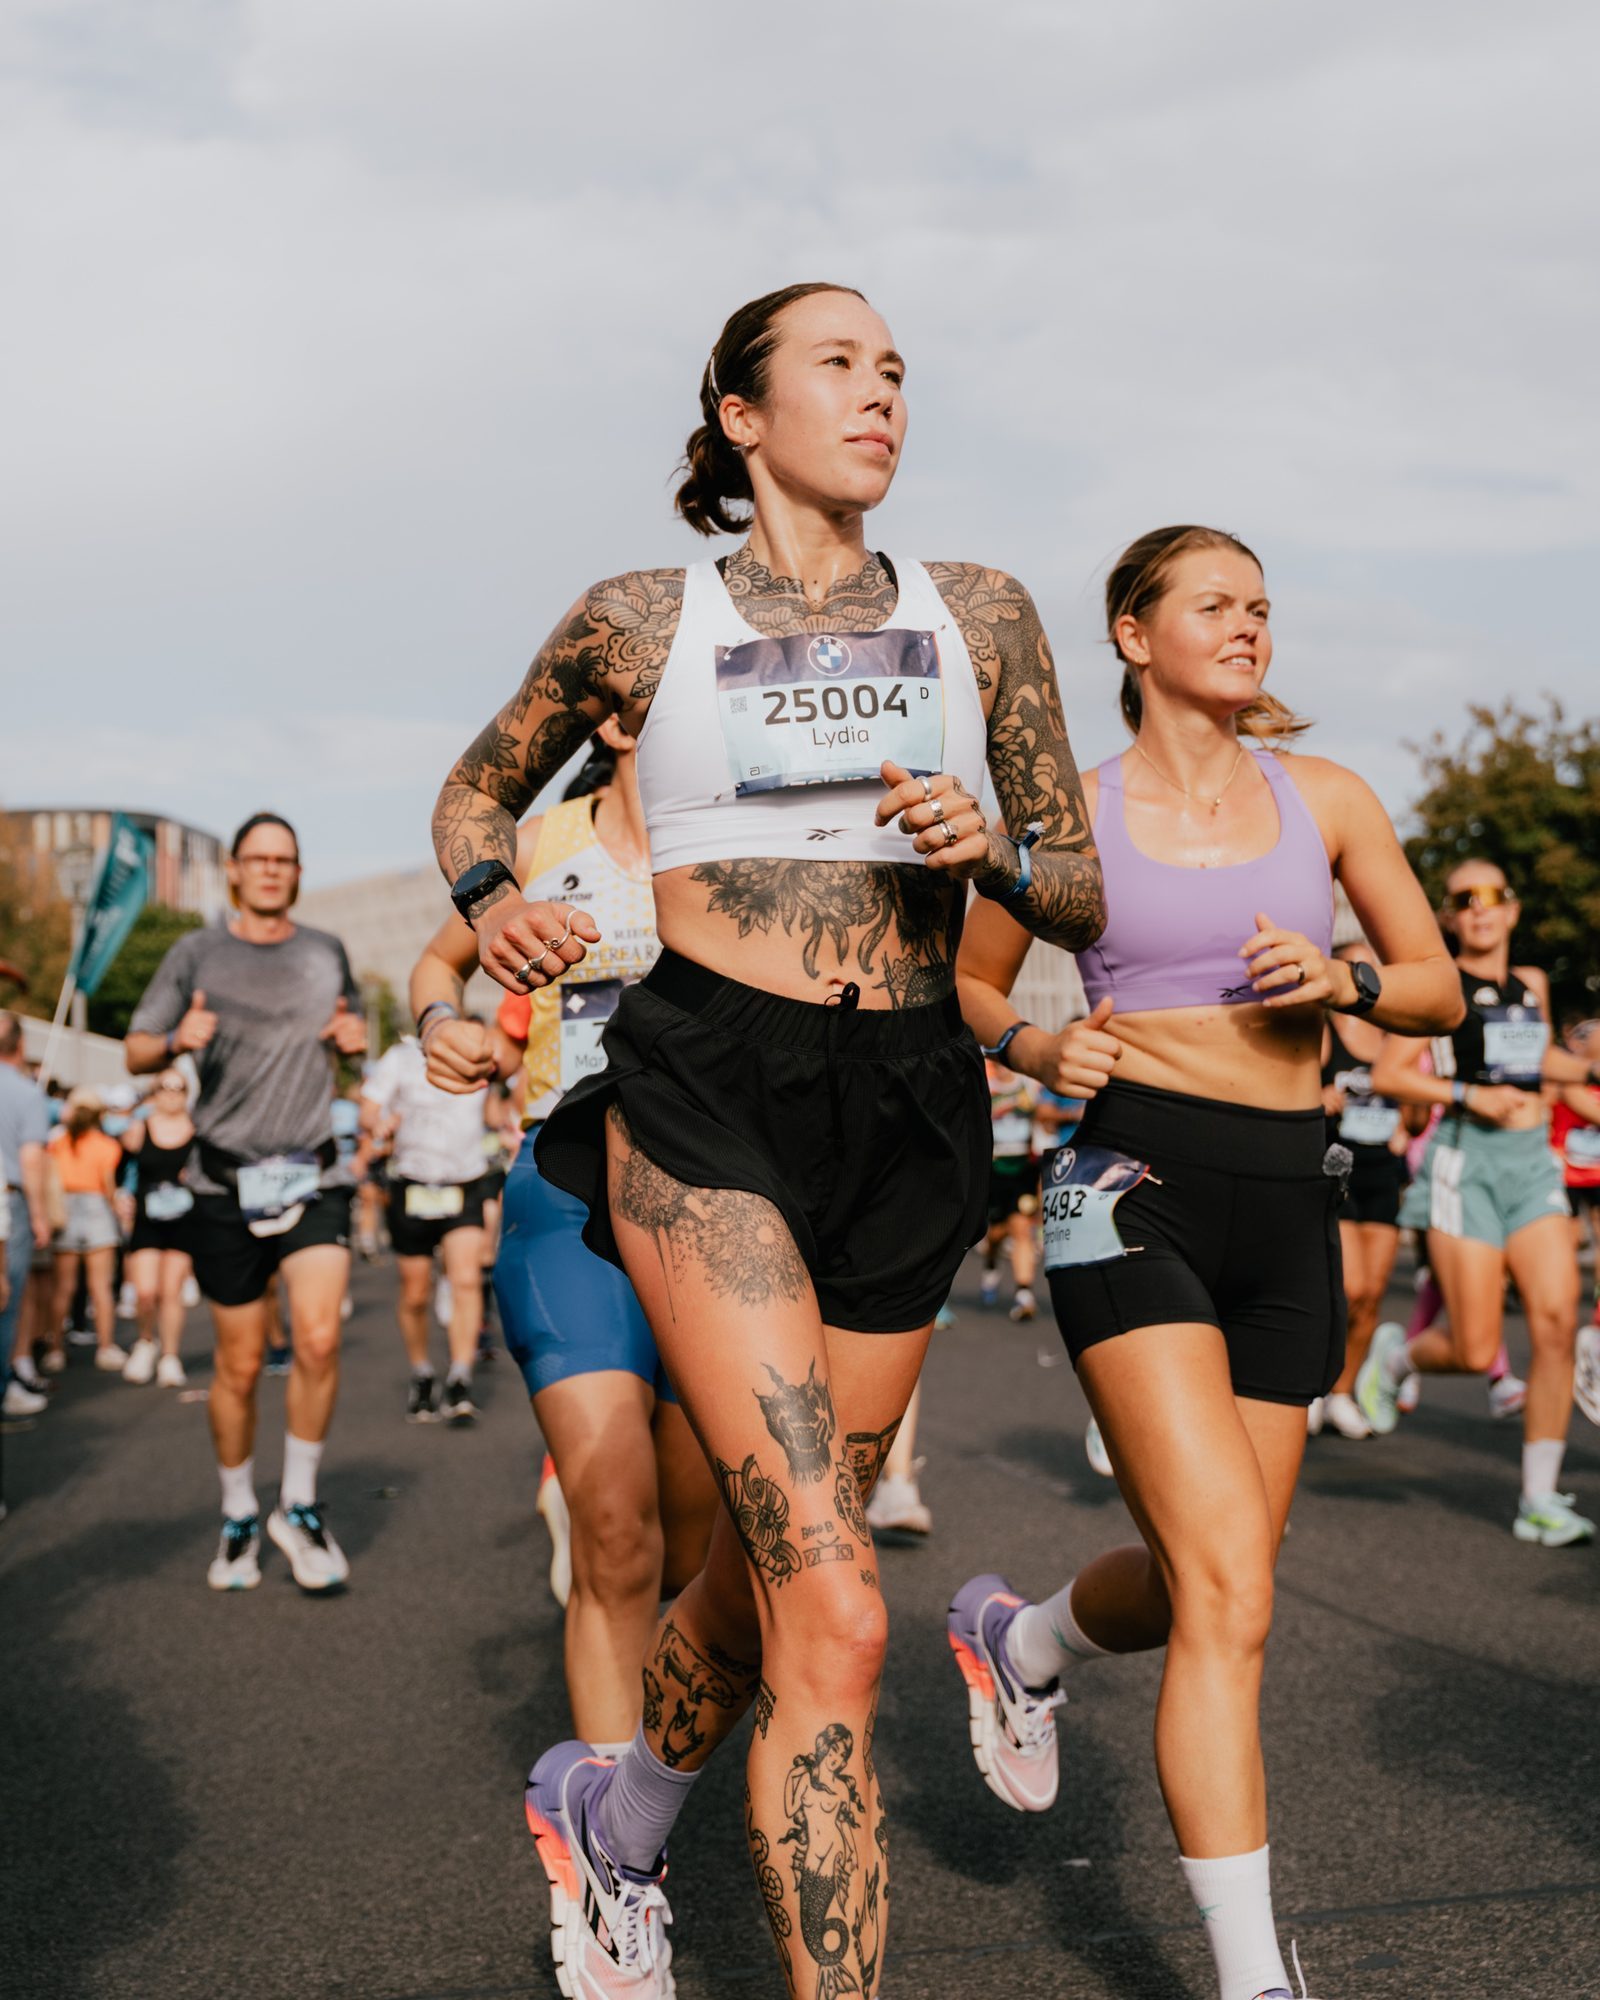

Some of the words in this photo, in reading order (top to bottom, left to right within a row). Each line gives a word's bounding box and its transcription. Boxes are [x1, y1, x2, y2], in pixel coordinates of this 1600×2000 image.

[762, 683, 908, 726] 25004
[919, 686, 930, 700] D
[812, 726, 870, 749] Lydia
[592, 1020, 608, 1048] 7
[1043, 1189, 1087, 1225] 6492
